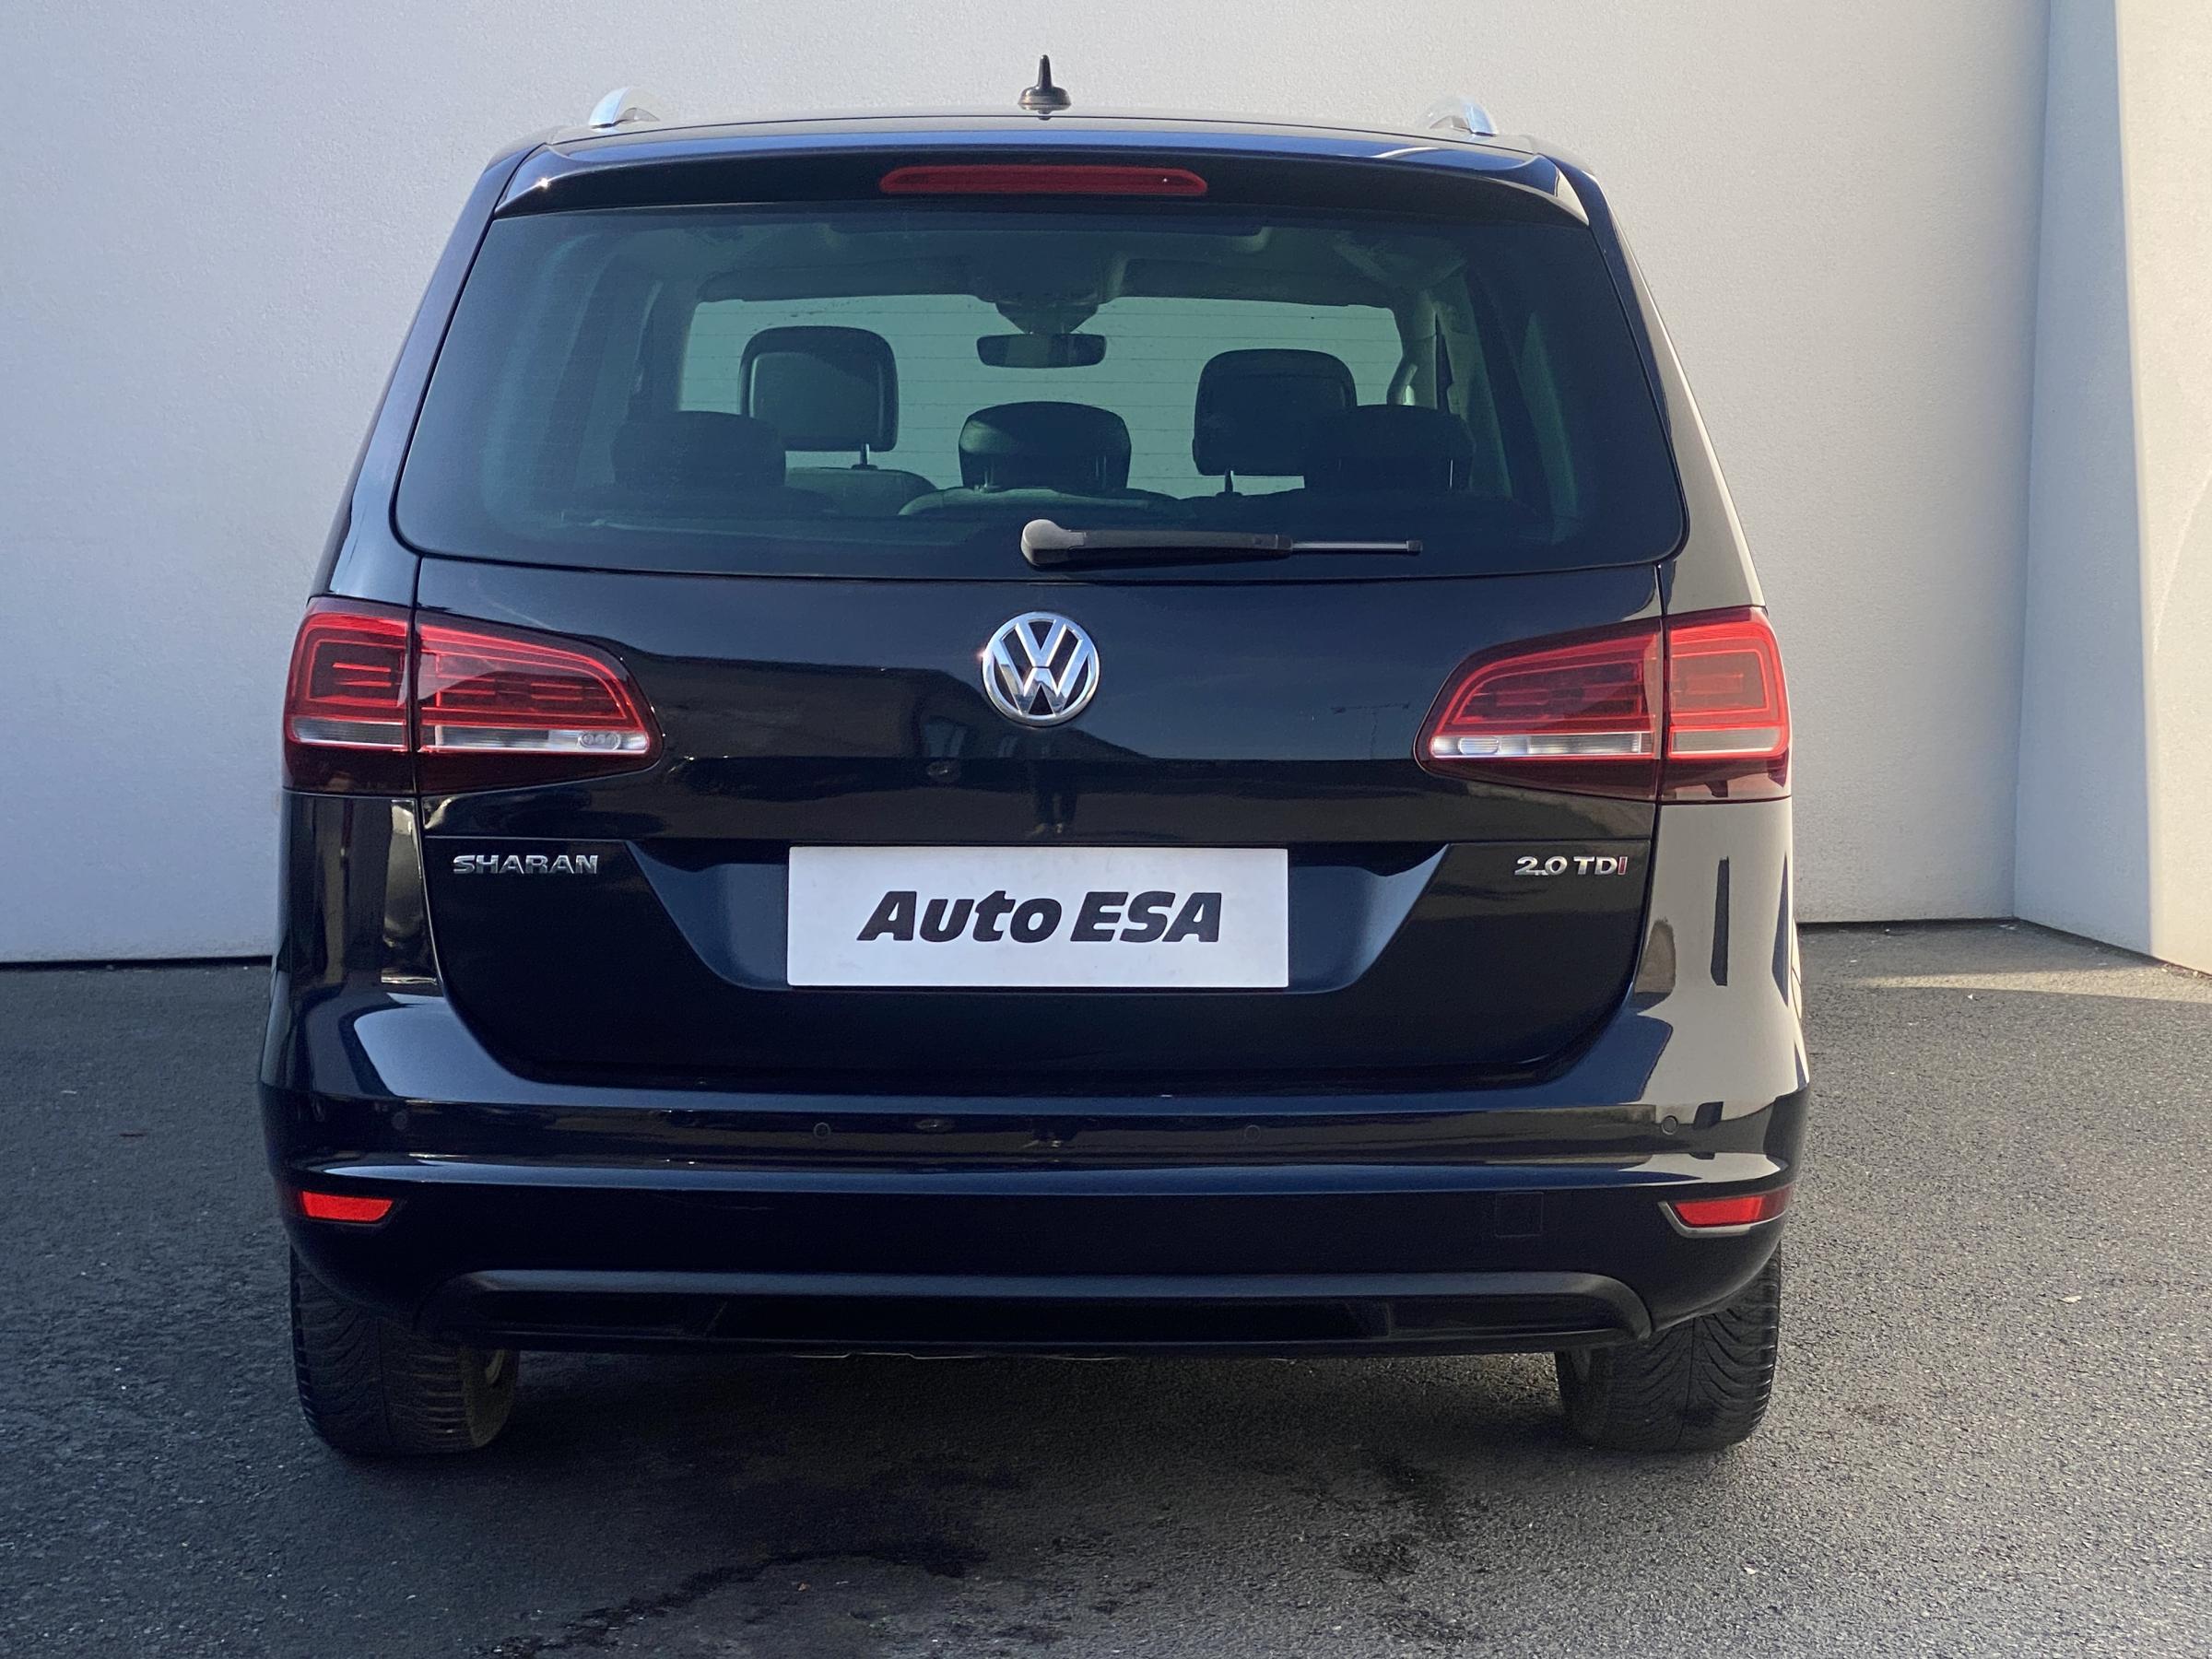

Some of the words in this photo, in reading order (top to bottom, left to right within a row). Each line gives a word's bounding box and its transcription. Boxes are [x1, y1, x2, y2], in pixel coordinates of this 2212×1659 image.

[985, 615, 1097, 724] VW
[453, 854, 599, 875] SHARAN
[1513, 855, 1568, 877] 2.0
[1573, 855, 1629, 876] TDI
[856, 889, 1063, 945] Auto
[1069, 890, 1222, 943] ESA
